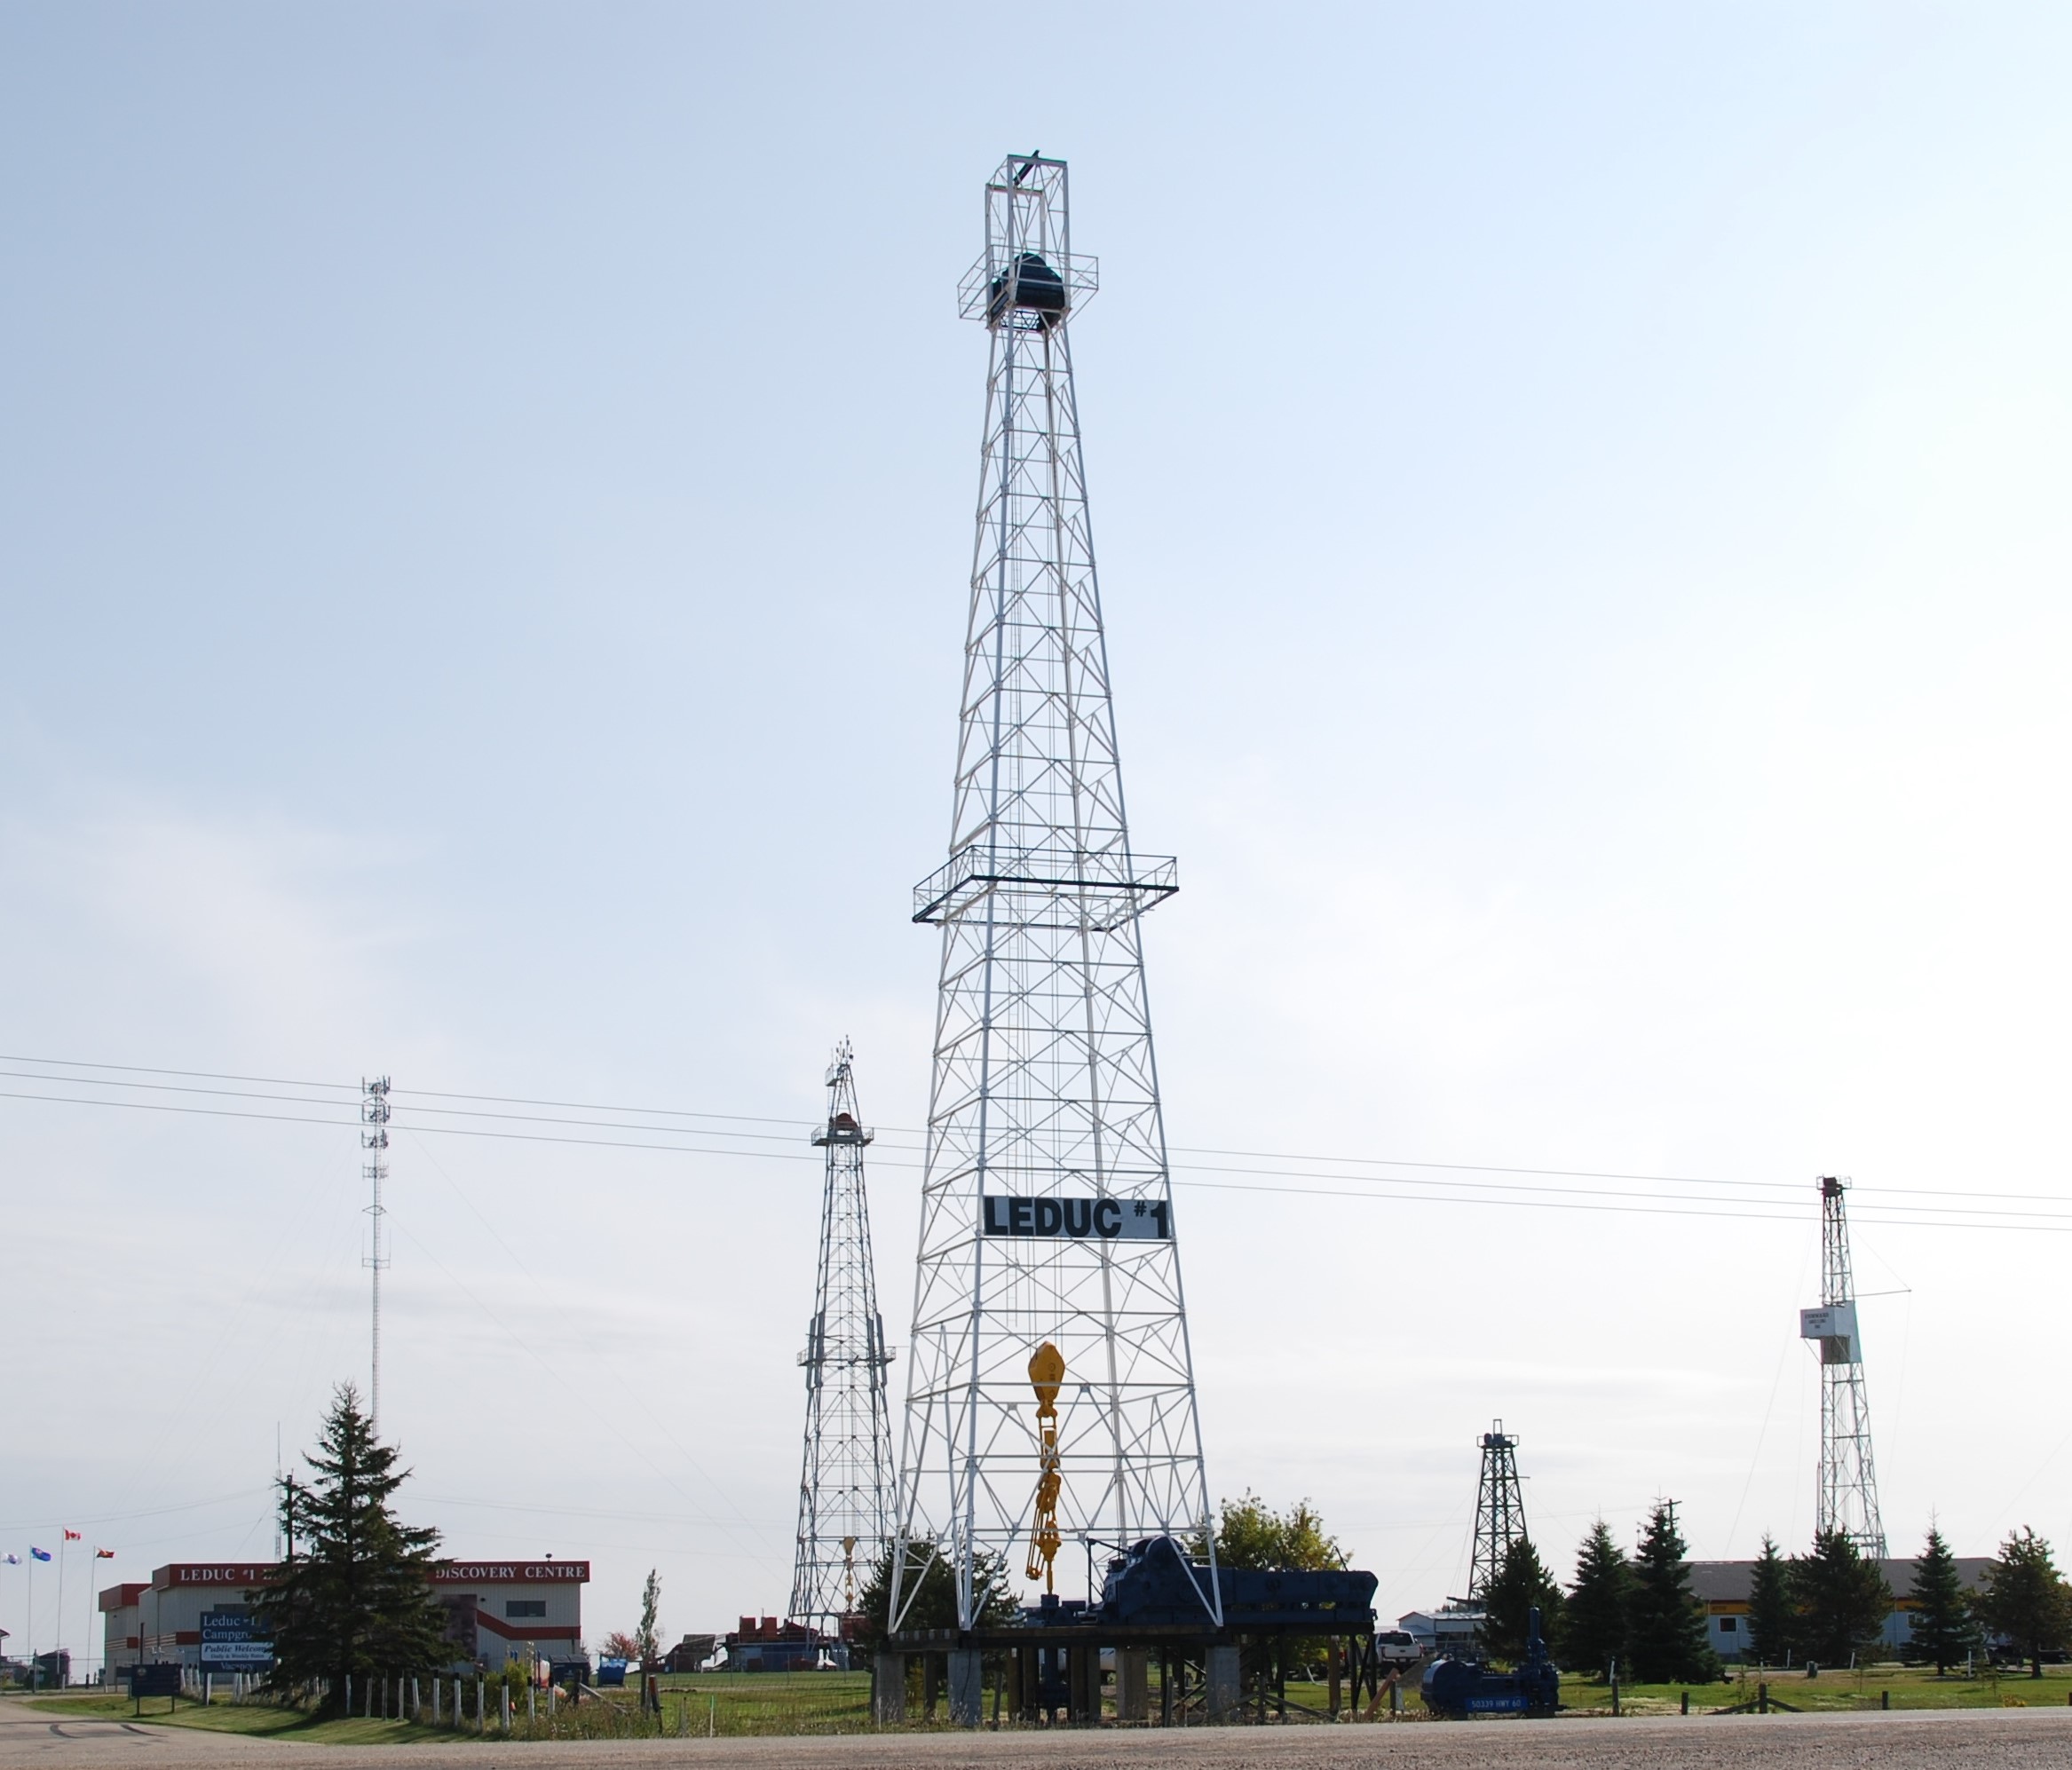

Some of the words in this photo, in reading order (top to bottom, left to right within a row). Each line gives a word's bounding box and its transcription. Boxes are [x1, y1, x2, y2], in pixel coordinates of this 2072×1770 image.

[985, 1197, 1122, 1238] LEDUC
[1134, 1200, 1167, 1238] #1
[180, 1569, 235, 1581] LEDUC
[435, 1566, 517, 1579] DISCOVERY
[525, 1566, 585, 1578] CENTRE
[203, 1615, 241, 1627] Leduc
[1512, 1699, 1522, 1708] 60
